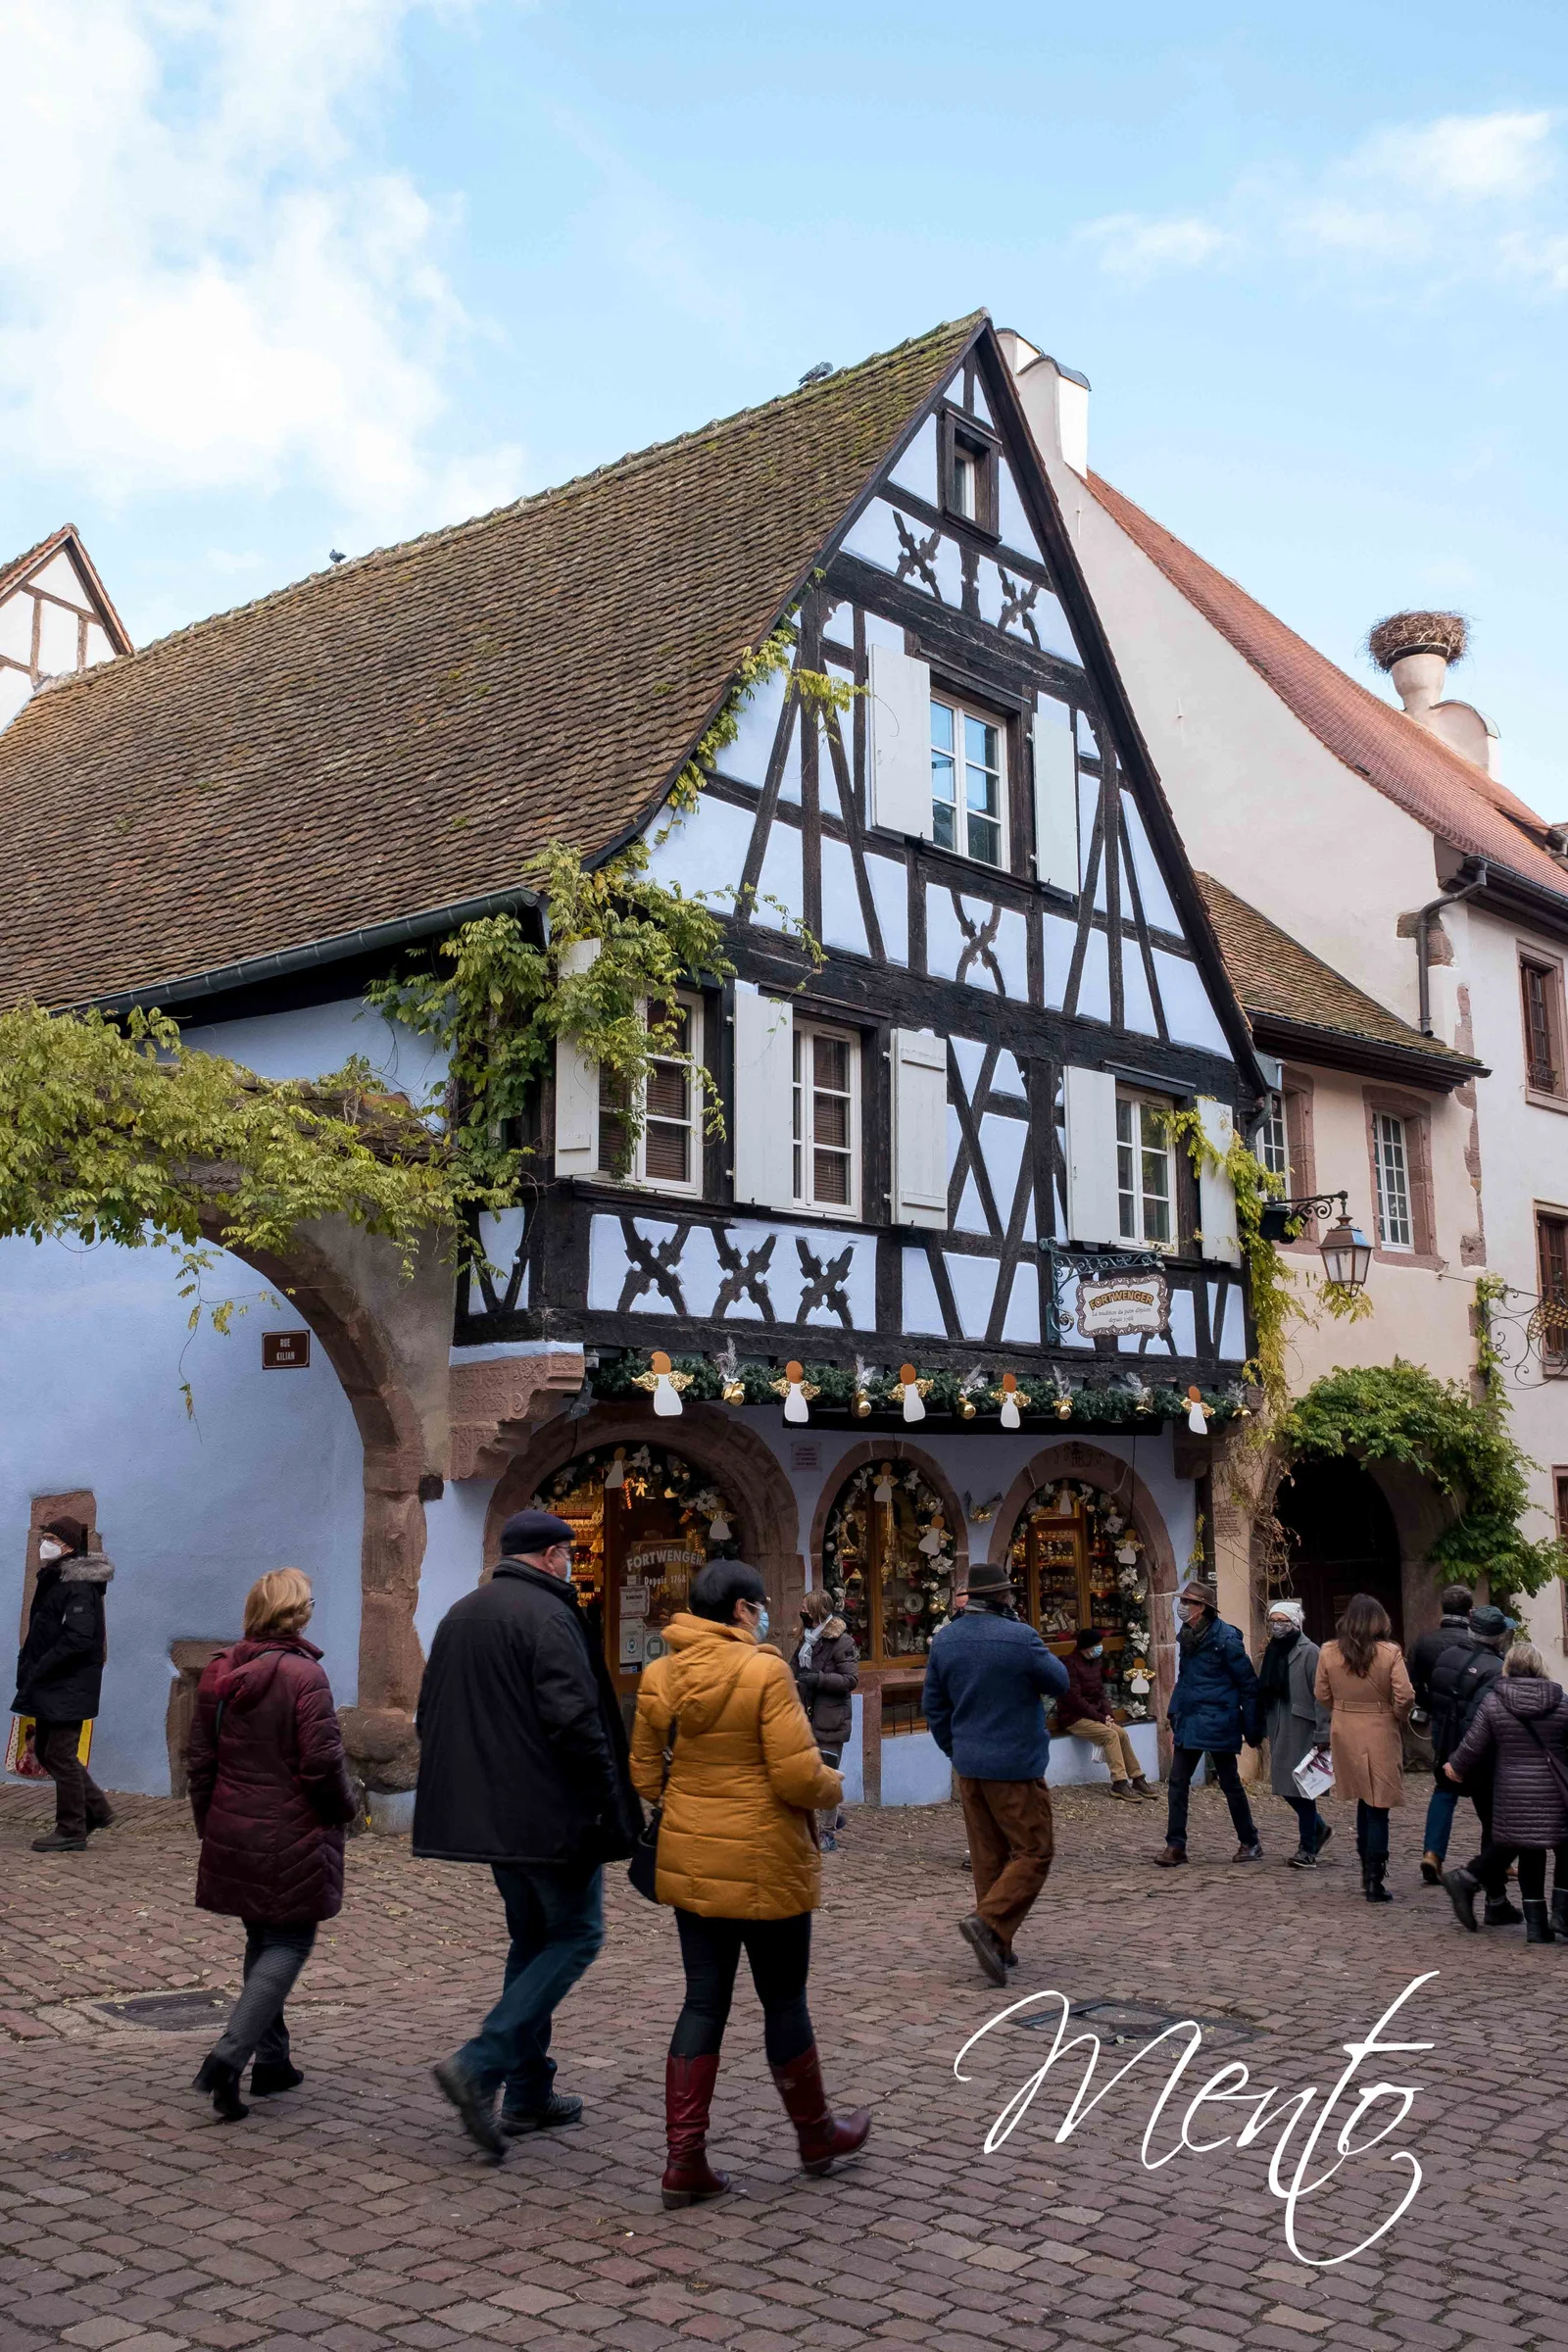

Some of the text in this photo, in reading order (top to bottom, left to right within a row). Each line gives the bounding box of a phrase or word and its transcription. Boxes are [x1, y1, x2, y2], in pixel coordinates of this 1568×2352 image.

[1089, 1290, 1154, 1310] FORTWENGER
[279, 1338, 291, 1348] RUE
[276, 1351, 295, 1361] KILIAN
[626, 1549, 703, 1573] FORTWENGER
[644, 1574, 686, 1588] Depuis 1768
